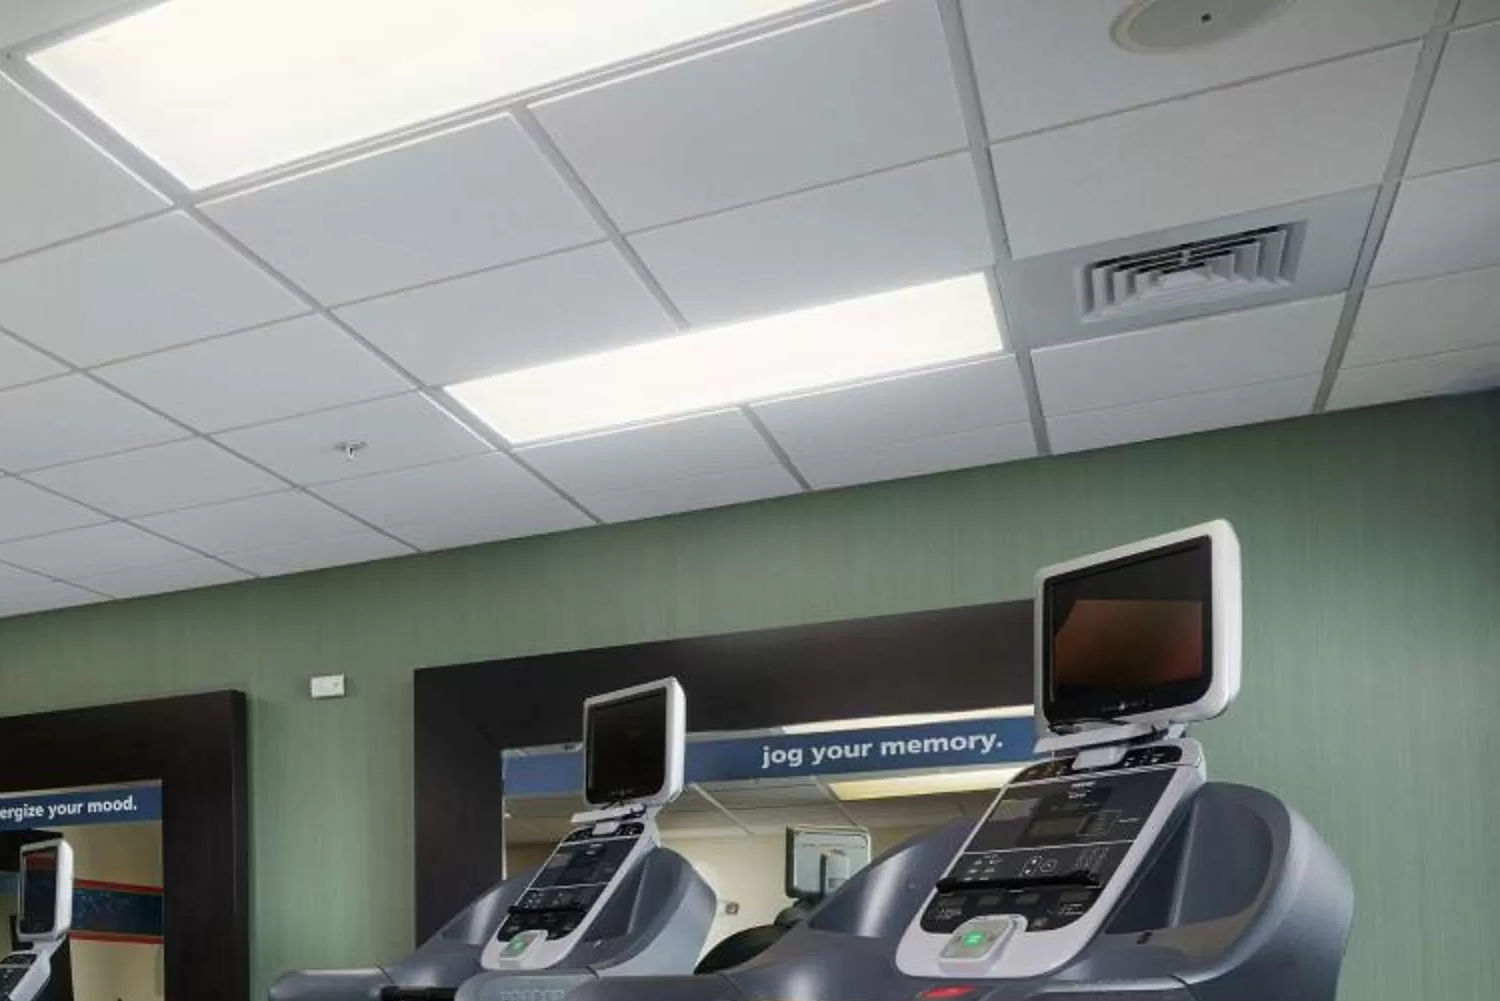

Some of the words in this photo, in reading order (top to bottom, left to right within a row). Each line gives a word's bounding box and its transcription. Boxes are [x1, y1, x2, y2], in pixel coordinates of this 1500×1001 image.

[761, 745, 803, 768] jog
[811, 741, 873, 765] your
[880, 733, 1003, 755] memory.
[48, 802, 83, 819] your
[87, 795, 137, 813] mood.
